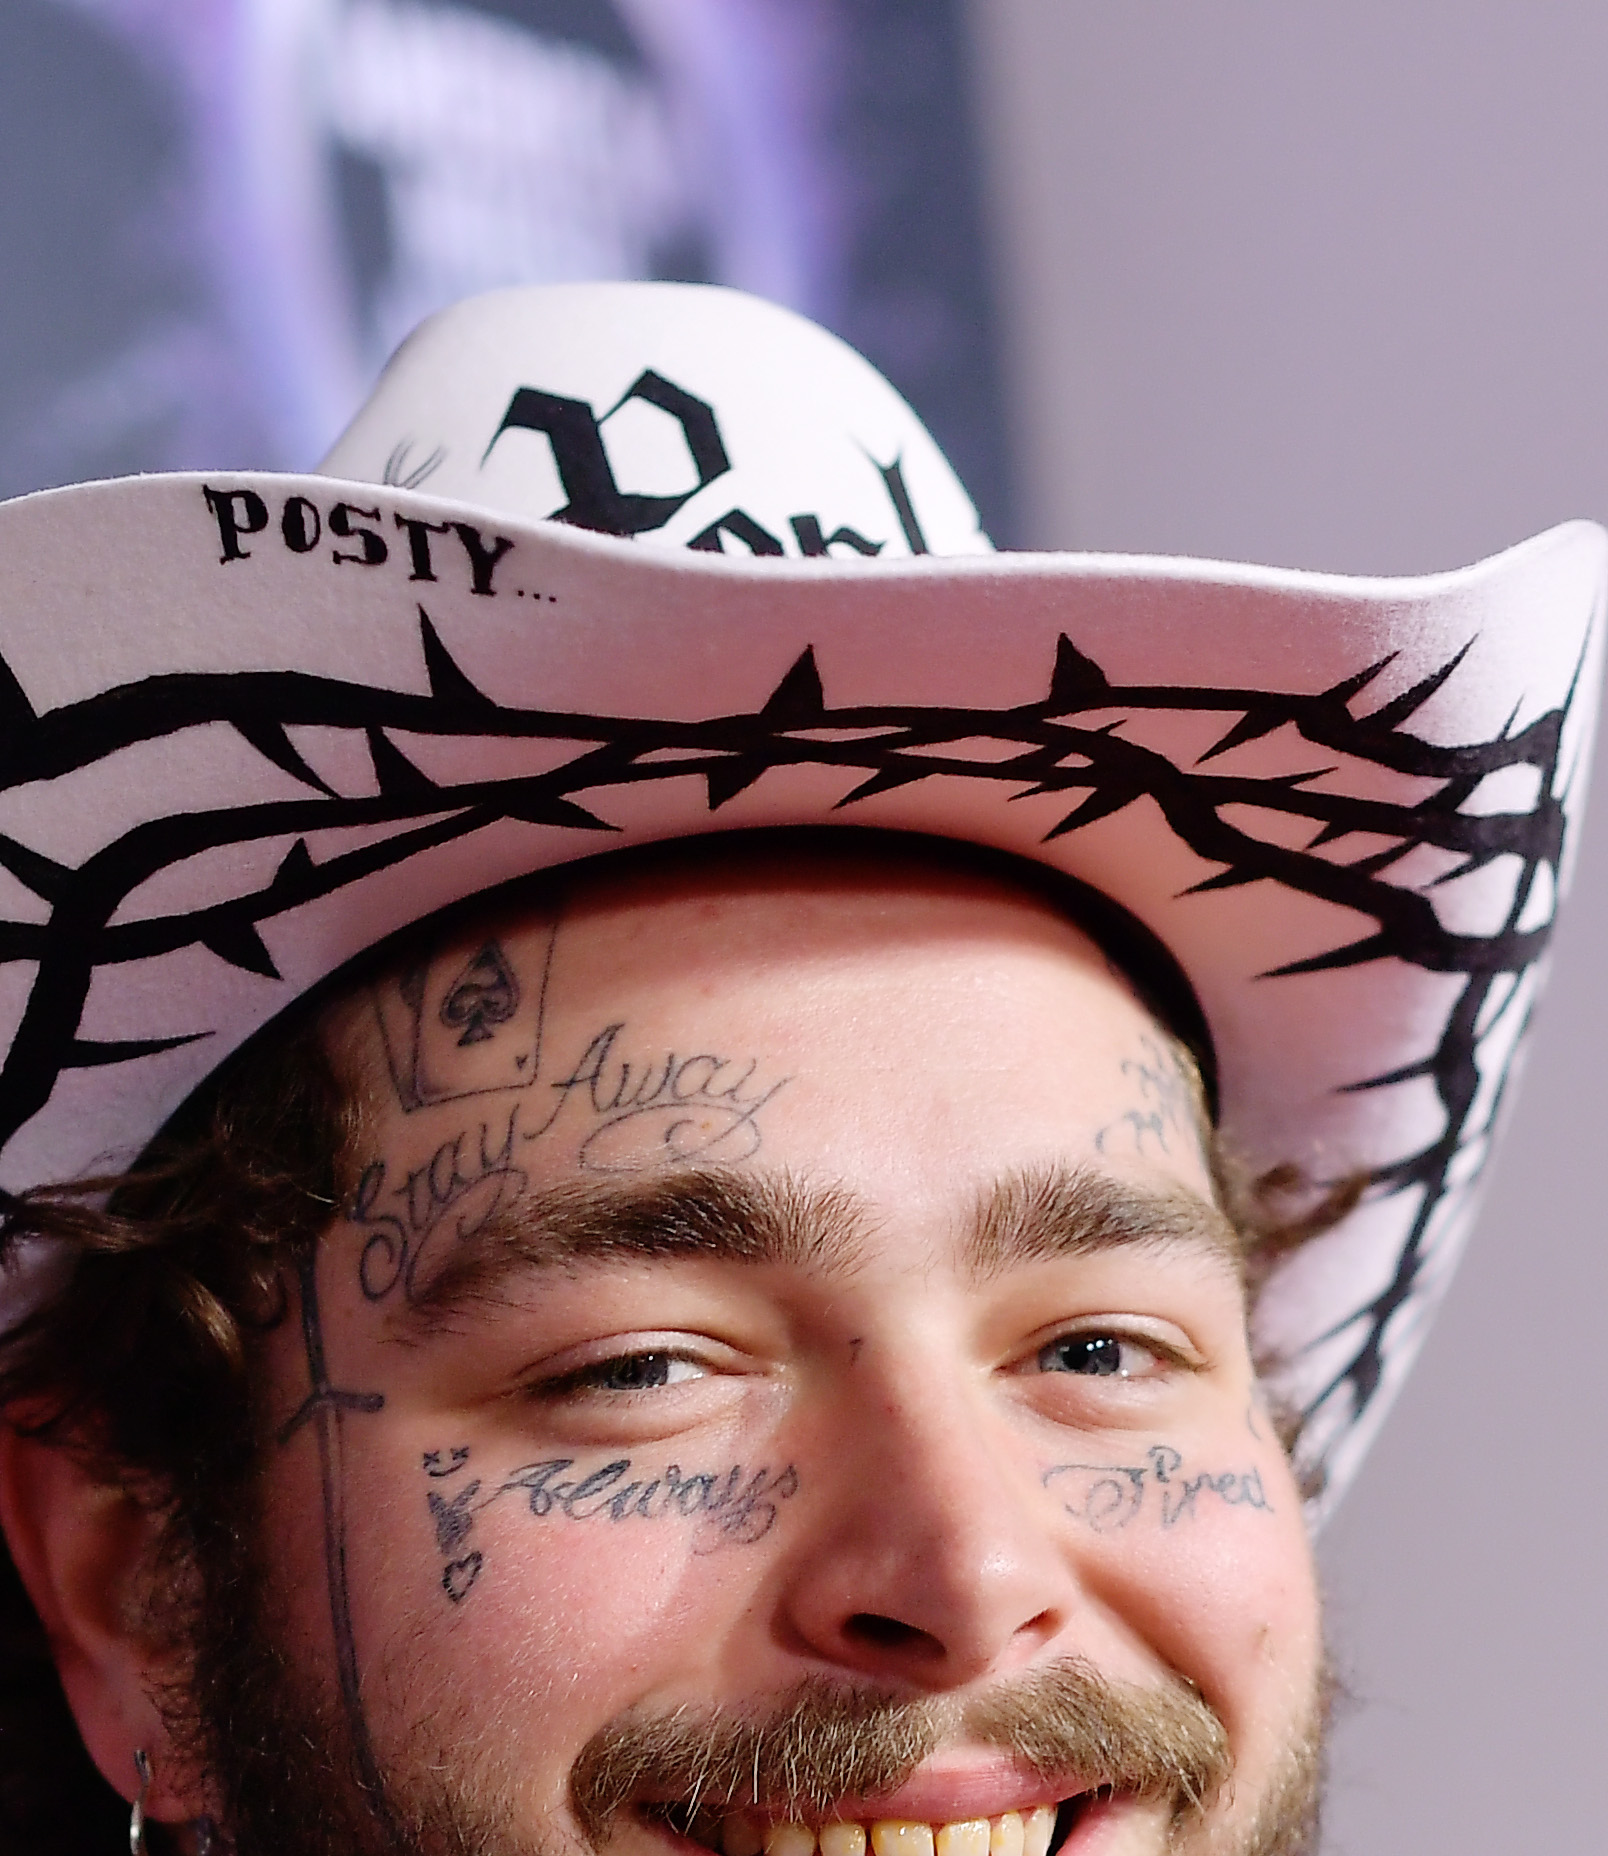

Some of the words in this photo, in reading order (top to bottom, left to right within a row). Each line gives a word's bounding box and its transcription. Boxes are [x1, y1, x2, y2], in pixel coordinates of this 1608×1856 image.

[522, 1022, 796, 1173] Away
[472, 1458, 800, 1557] Always
[1042, 1444, 1274, 1534] Tired
